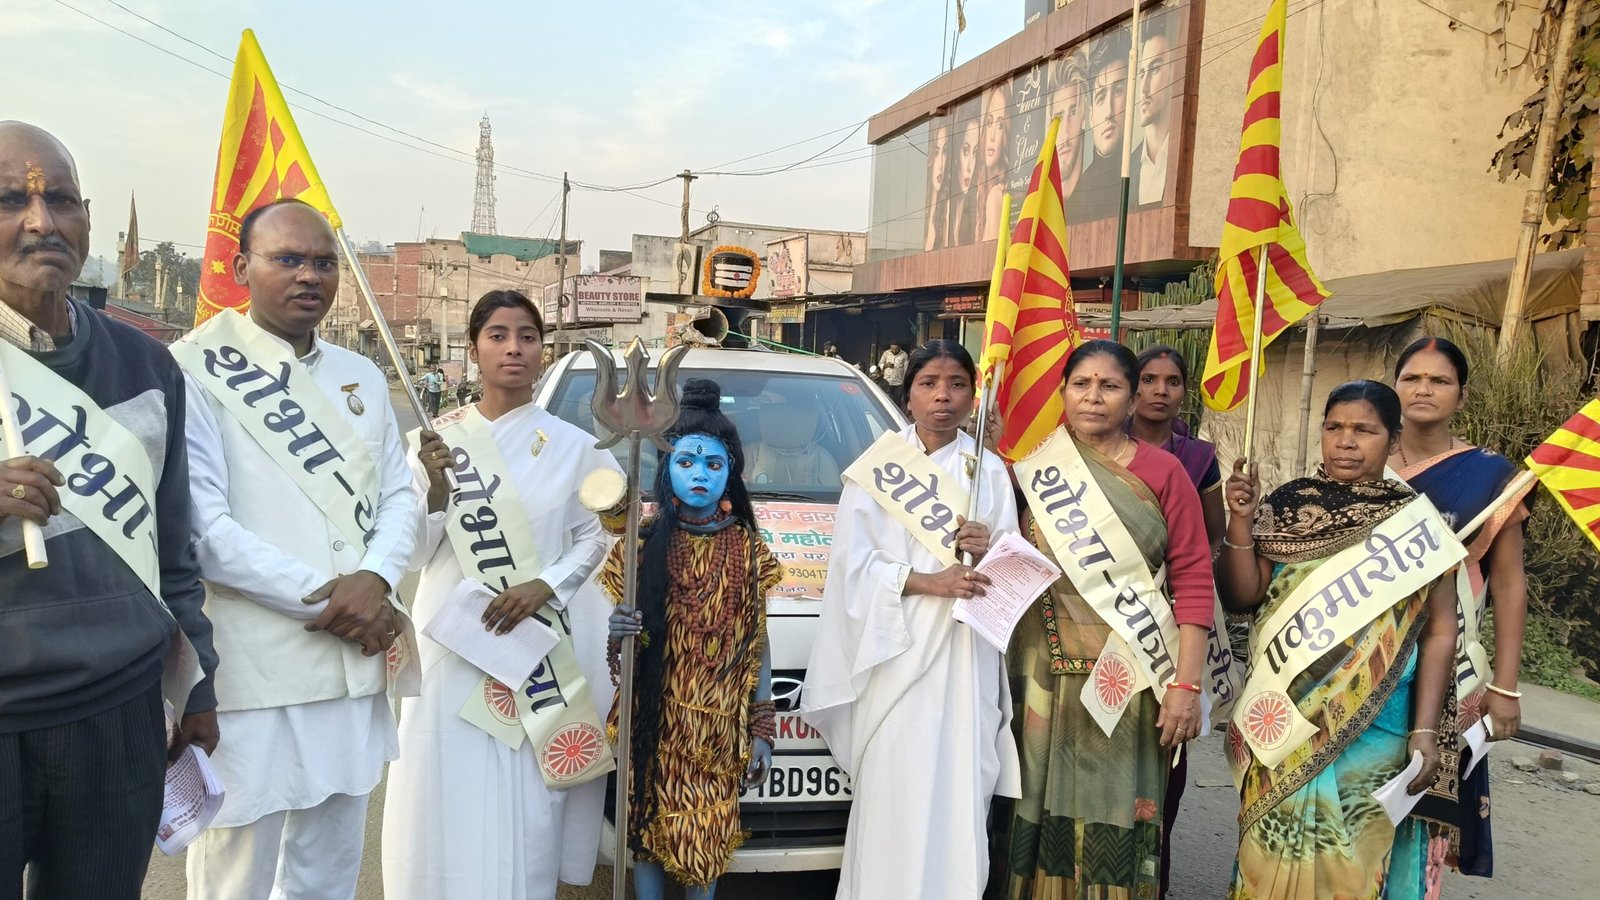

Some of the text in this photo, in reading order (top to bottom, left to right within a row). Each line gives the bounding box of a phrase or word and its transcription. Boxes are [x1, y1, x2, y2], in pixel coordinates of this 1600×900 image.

[1023, 115, 1032, 134] &
[1013, 134, 1039, 174] Glow
[579, 291, 640, 301] BEAUTY STORE
